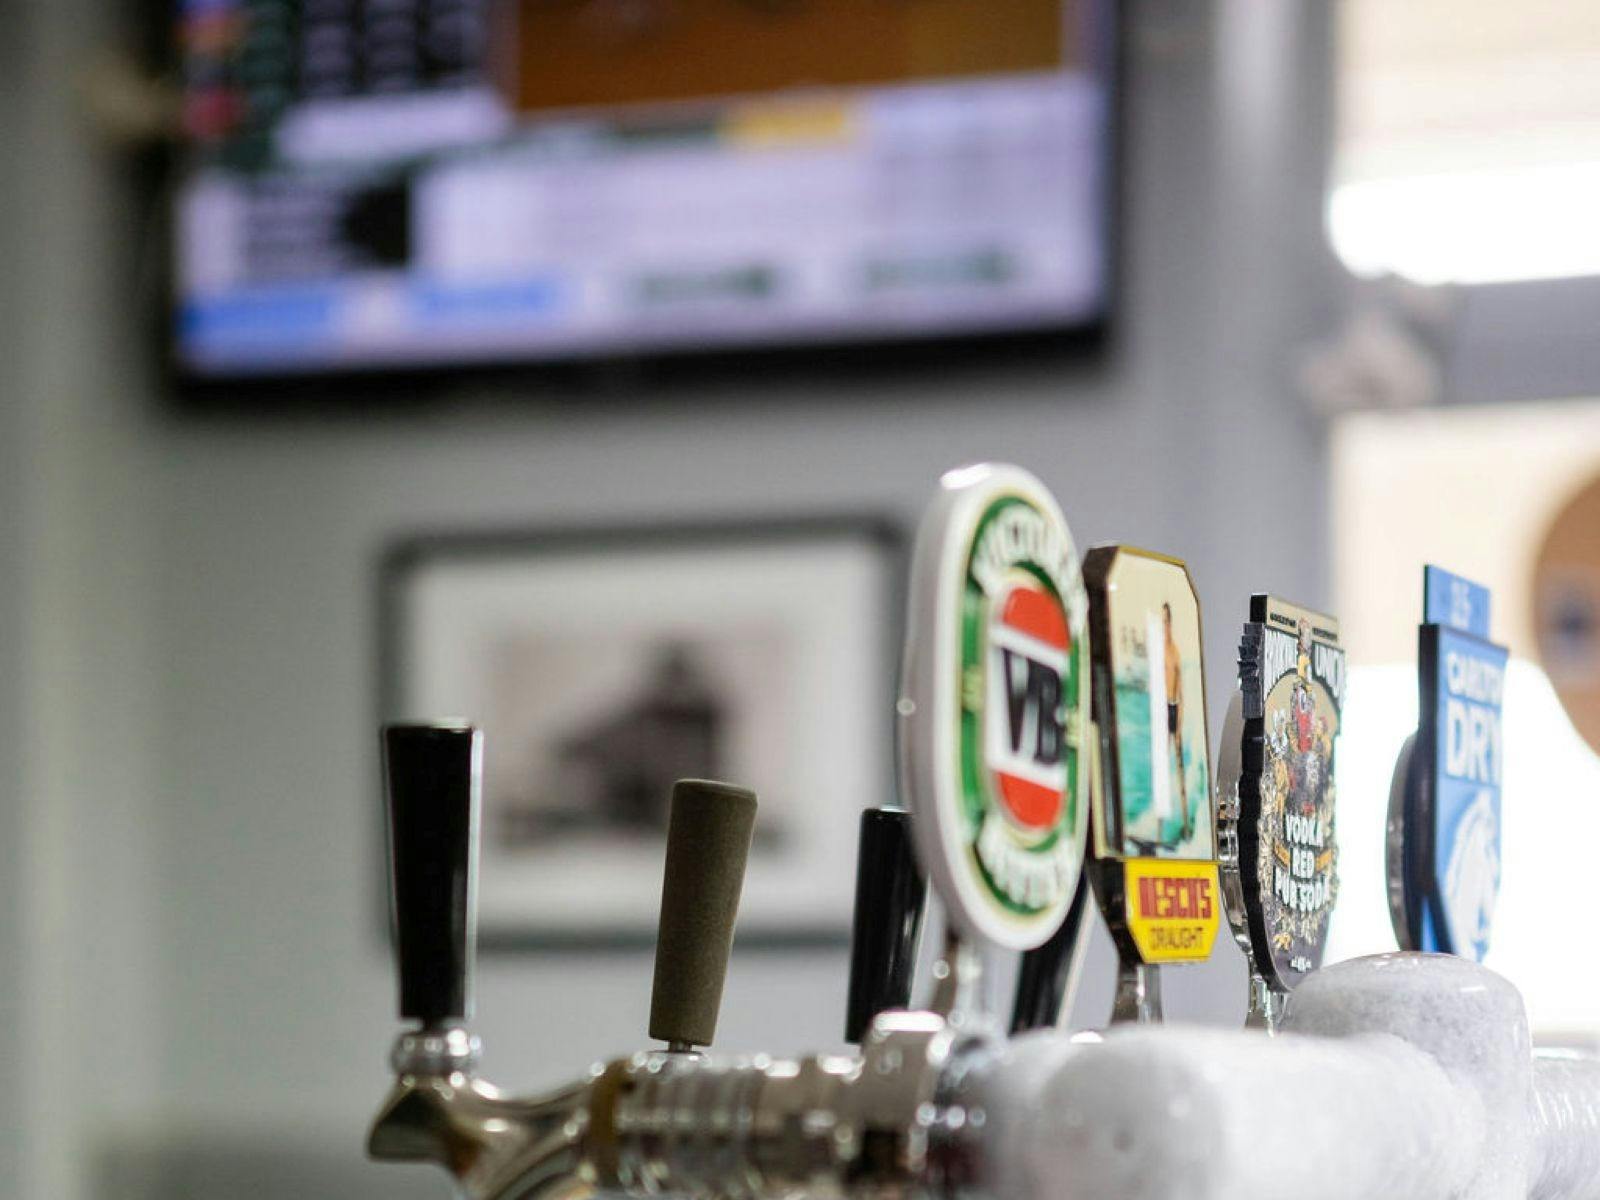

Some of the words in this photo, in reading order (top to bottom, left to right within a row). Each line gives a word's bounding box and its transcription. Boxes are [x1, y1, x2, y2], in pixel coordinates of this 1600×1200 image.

[1001, 645, 1065, 766] VB
[1446, 701, 1501, 788] DRY
[1285, 813, 1324, 847] VODKA
[1291, 850, 1315, 878] RED
[1149, 926, 1204, 951] DRAUGHT
